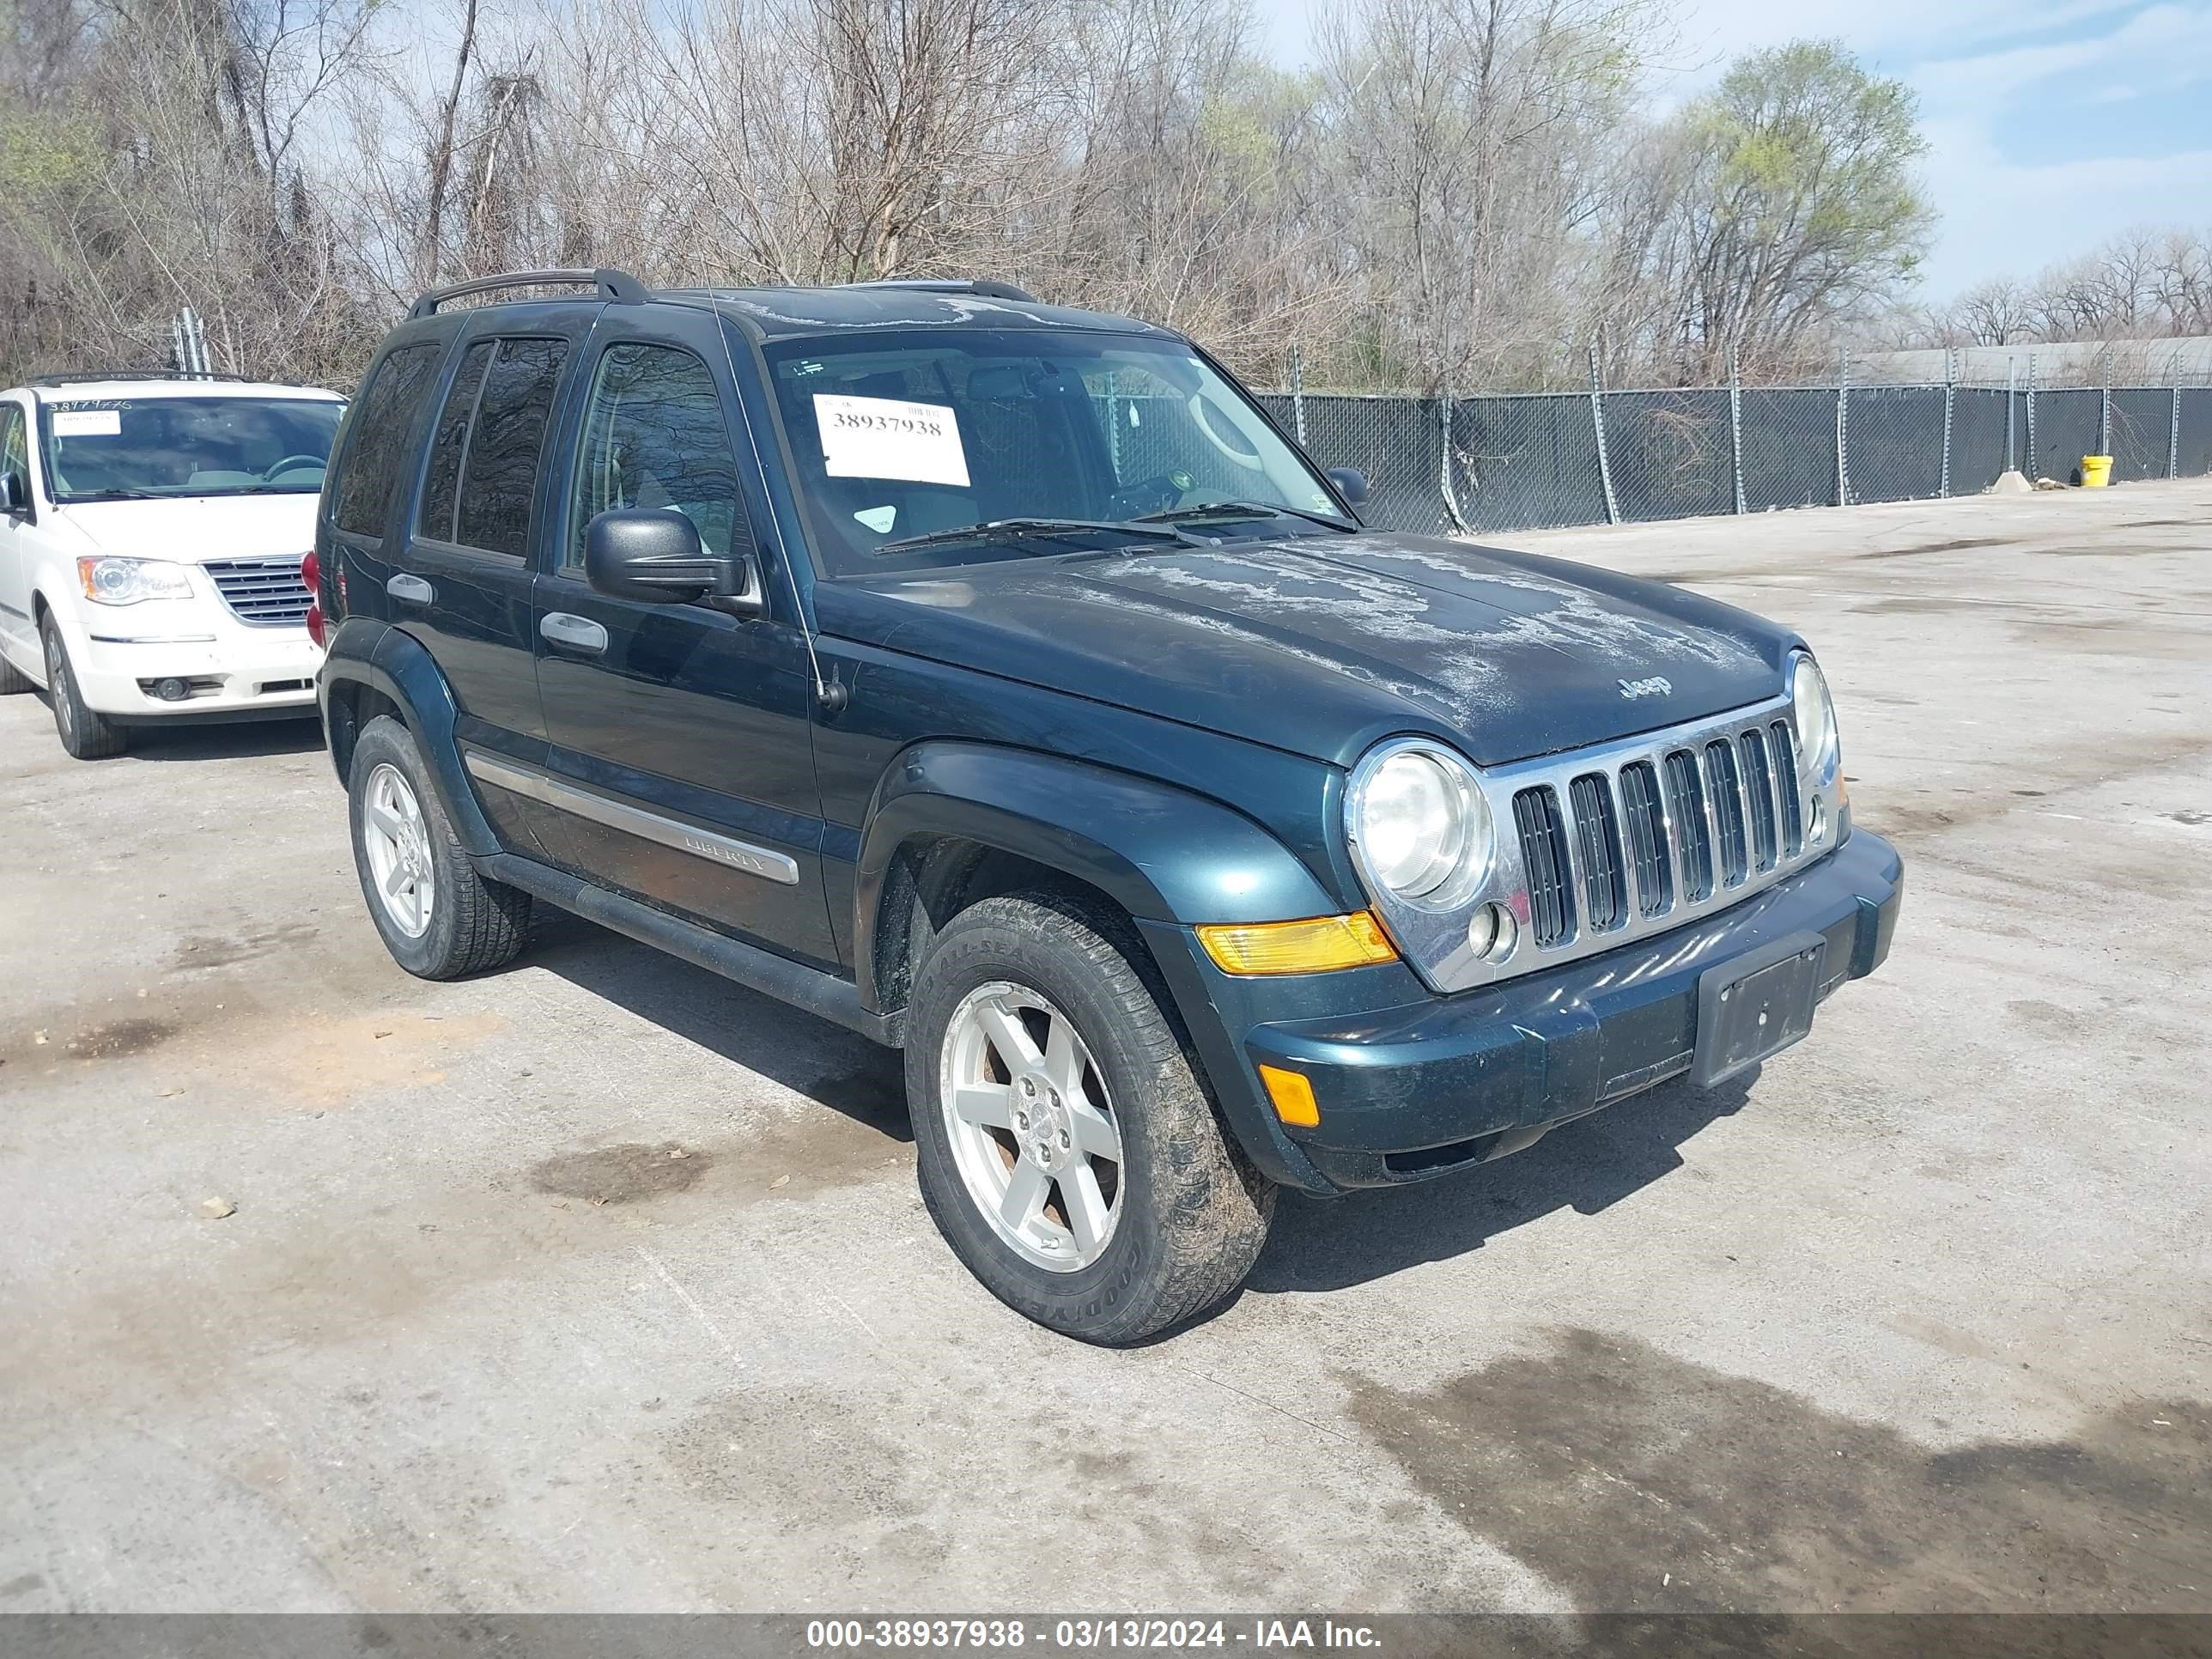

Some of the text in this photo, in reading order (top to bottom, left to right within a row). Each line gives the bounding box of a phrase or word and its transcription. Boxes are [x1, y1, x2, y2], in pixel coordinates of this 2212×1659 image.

[833, 412, 942, 437] 38937938
[1617, 676, 1673, 700] Jeep
[685, 836, 765, 870] LIBERTY
